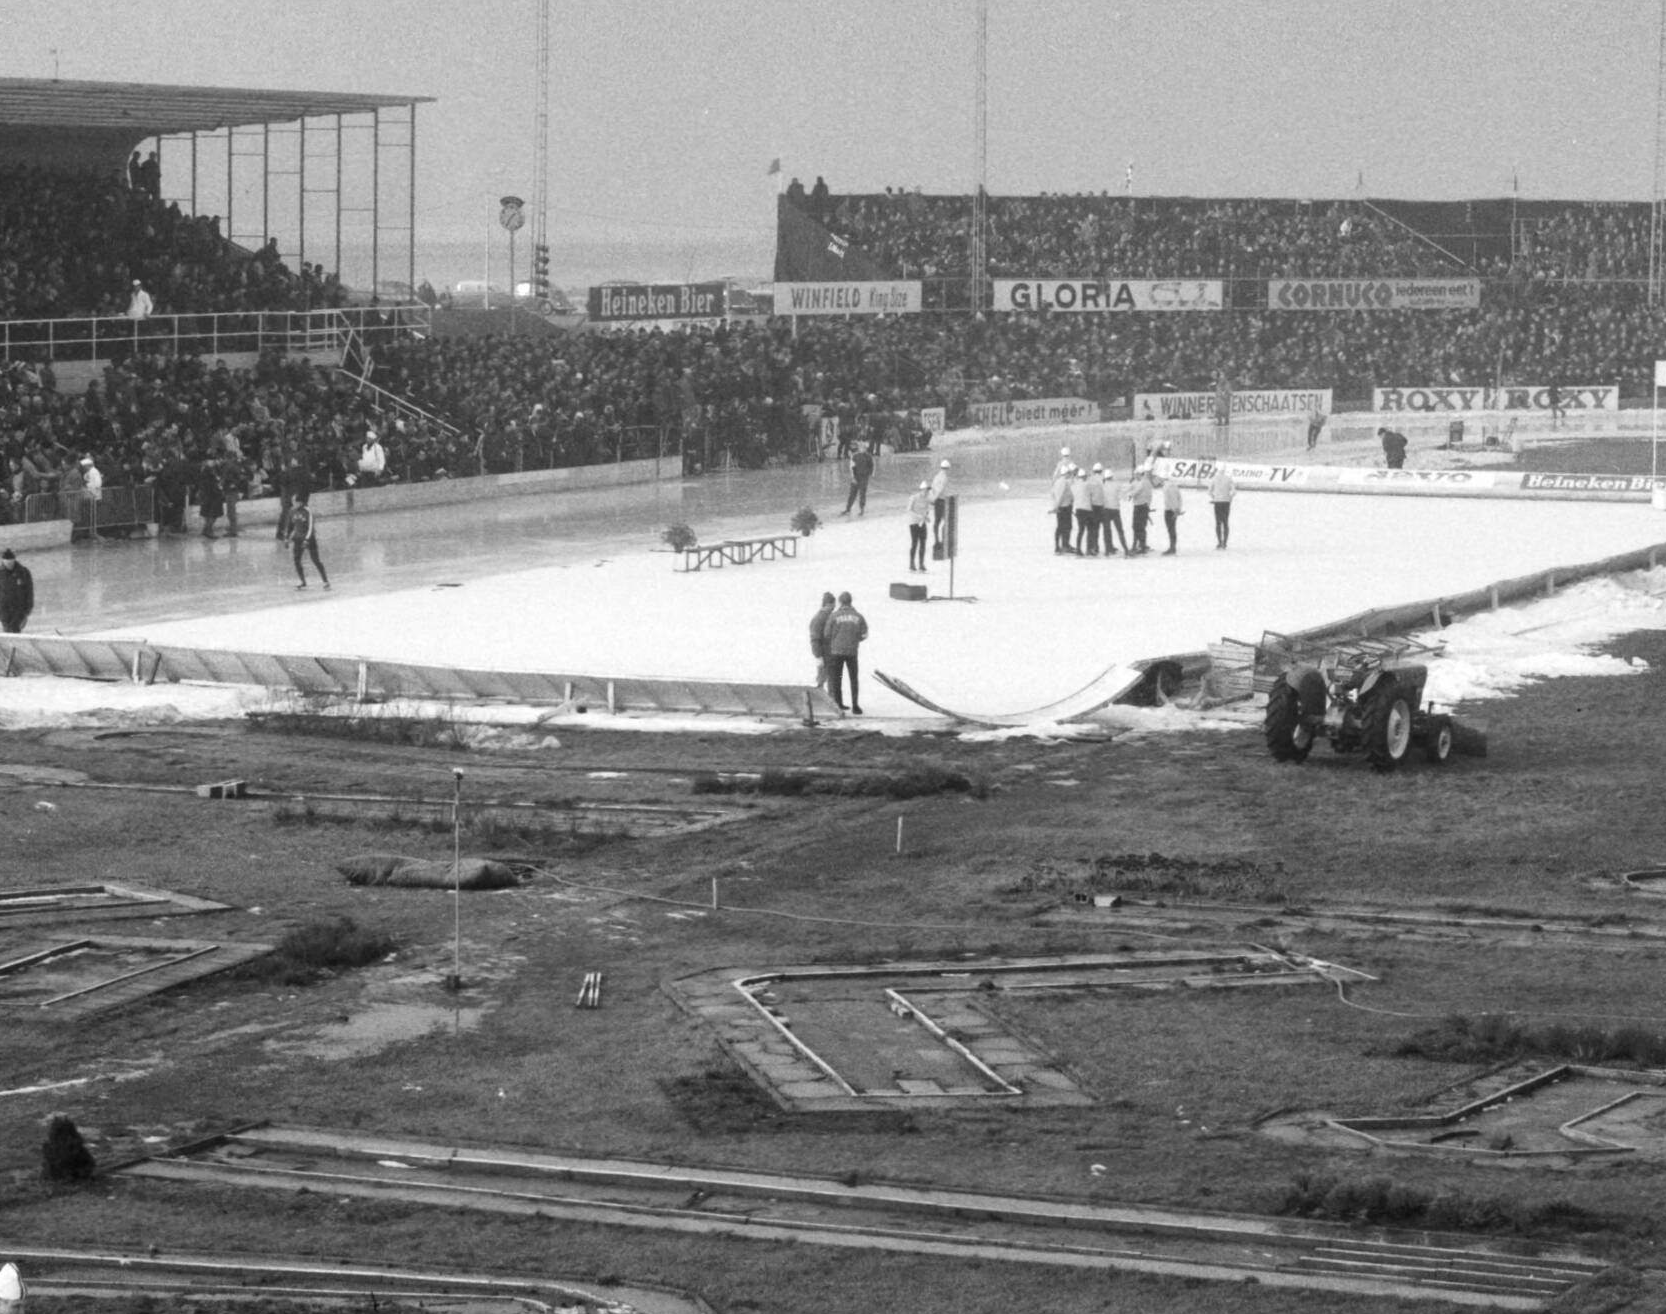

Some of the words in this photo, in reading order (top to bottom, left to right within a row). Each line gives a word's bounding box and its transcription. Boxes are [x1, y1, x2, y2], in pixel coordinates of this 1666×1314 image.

[601, 286, 676, 316] Heineken
[680, 286, 715, 314] Bier
[791, 287, 861, 309] WINFIELD
[1011, 283, 1136, 309] GLORIA
[1161, 396, 1214, 415] WINNER
[1231, 393, 1323, 413] ENSCHAATSEN
[1380, 388, 1480, 412] ROXY
[1504, 388, 1613, 411] ROXY
[1015, 405, 1046, 421] biedt
[1269, 467, 1296, 482] TV
[1526, 474, 1627, 490] Heineken
